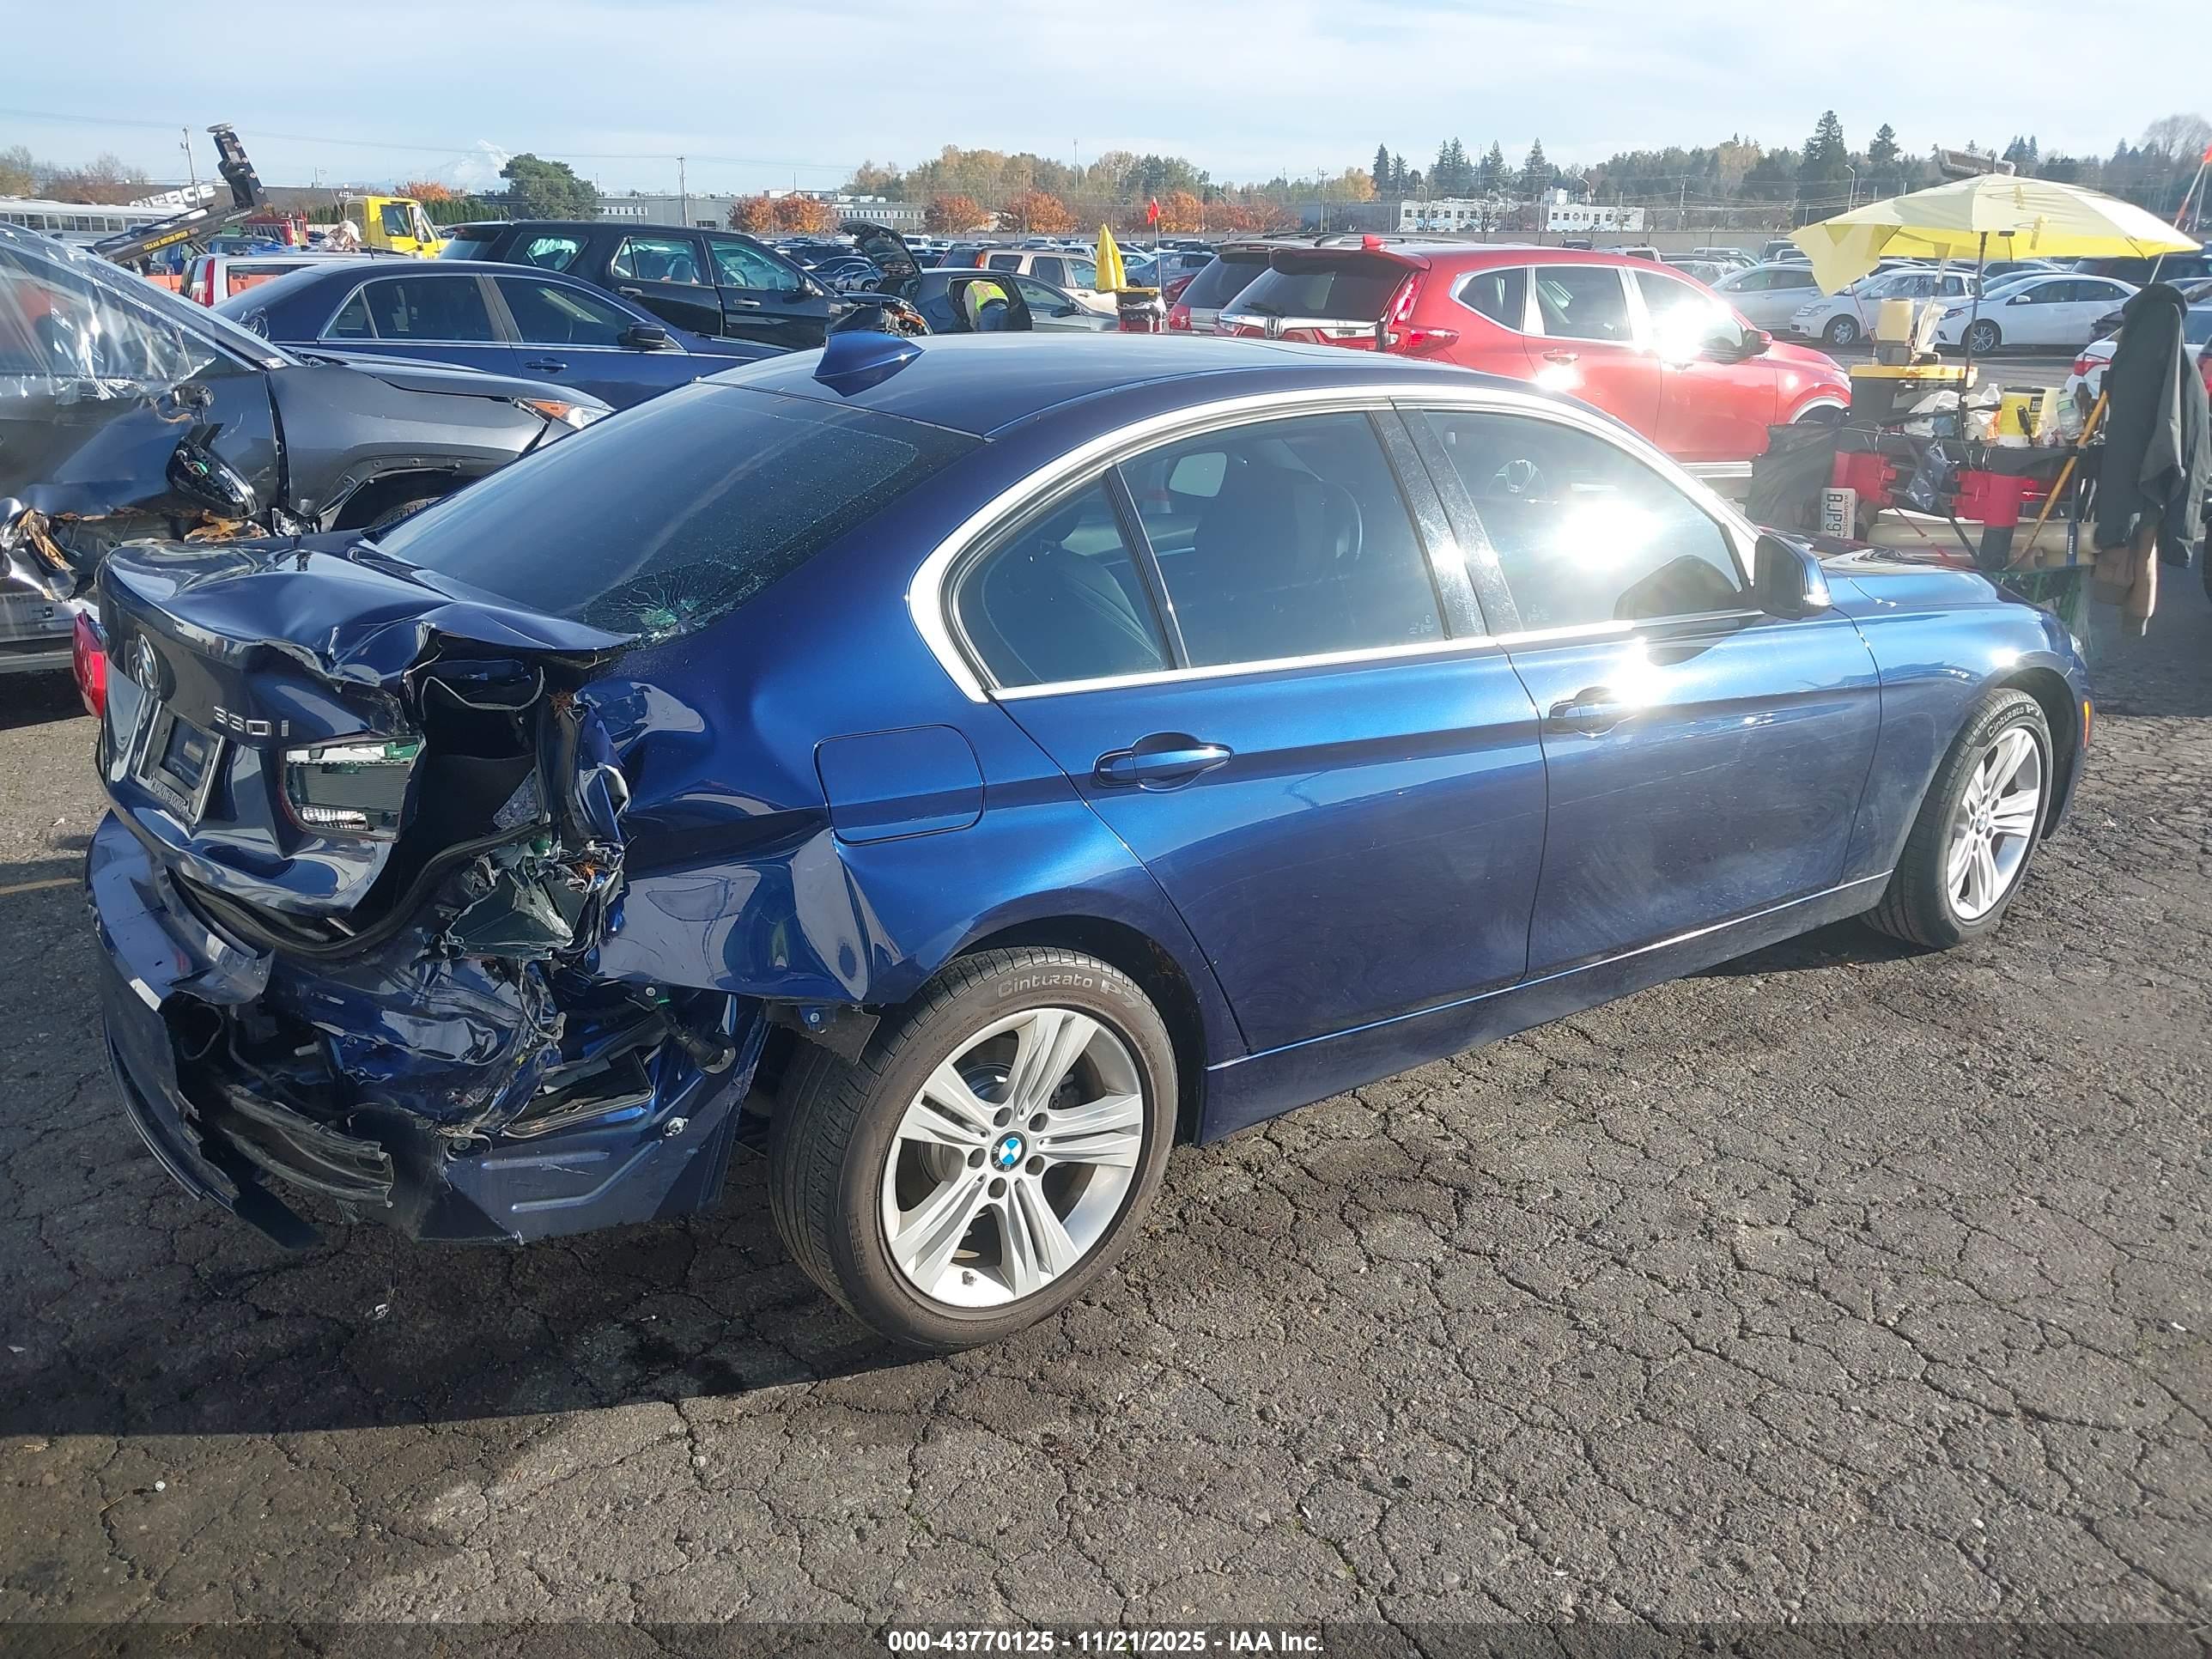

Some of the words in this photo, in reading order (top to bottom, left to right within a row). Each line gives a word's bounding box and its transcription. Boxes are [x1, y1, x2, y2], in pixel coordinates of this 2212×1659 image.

[1826, 494, 1843, 537] BJP9
[1987, 707, 2025, 738] Cinturato
[2026, 704, 2040, 717] P7
[997, 973, 1093, 999] Cinturato
[1100, 978, 1143, 1010] P7
